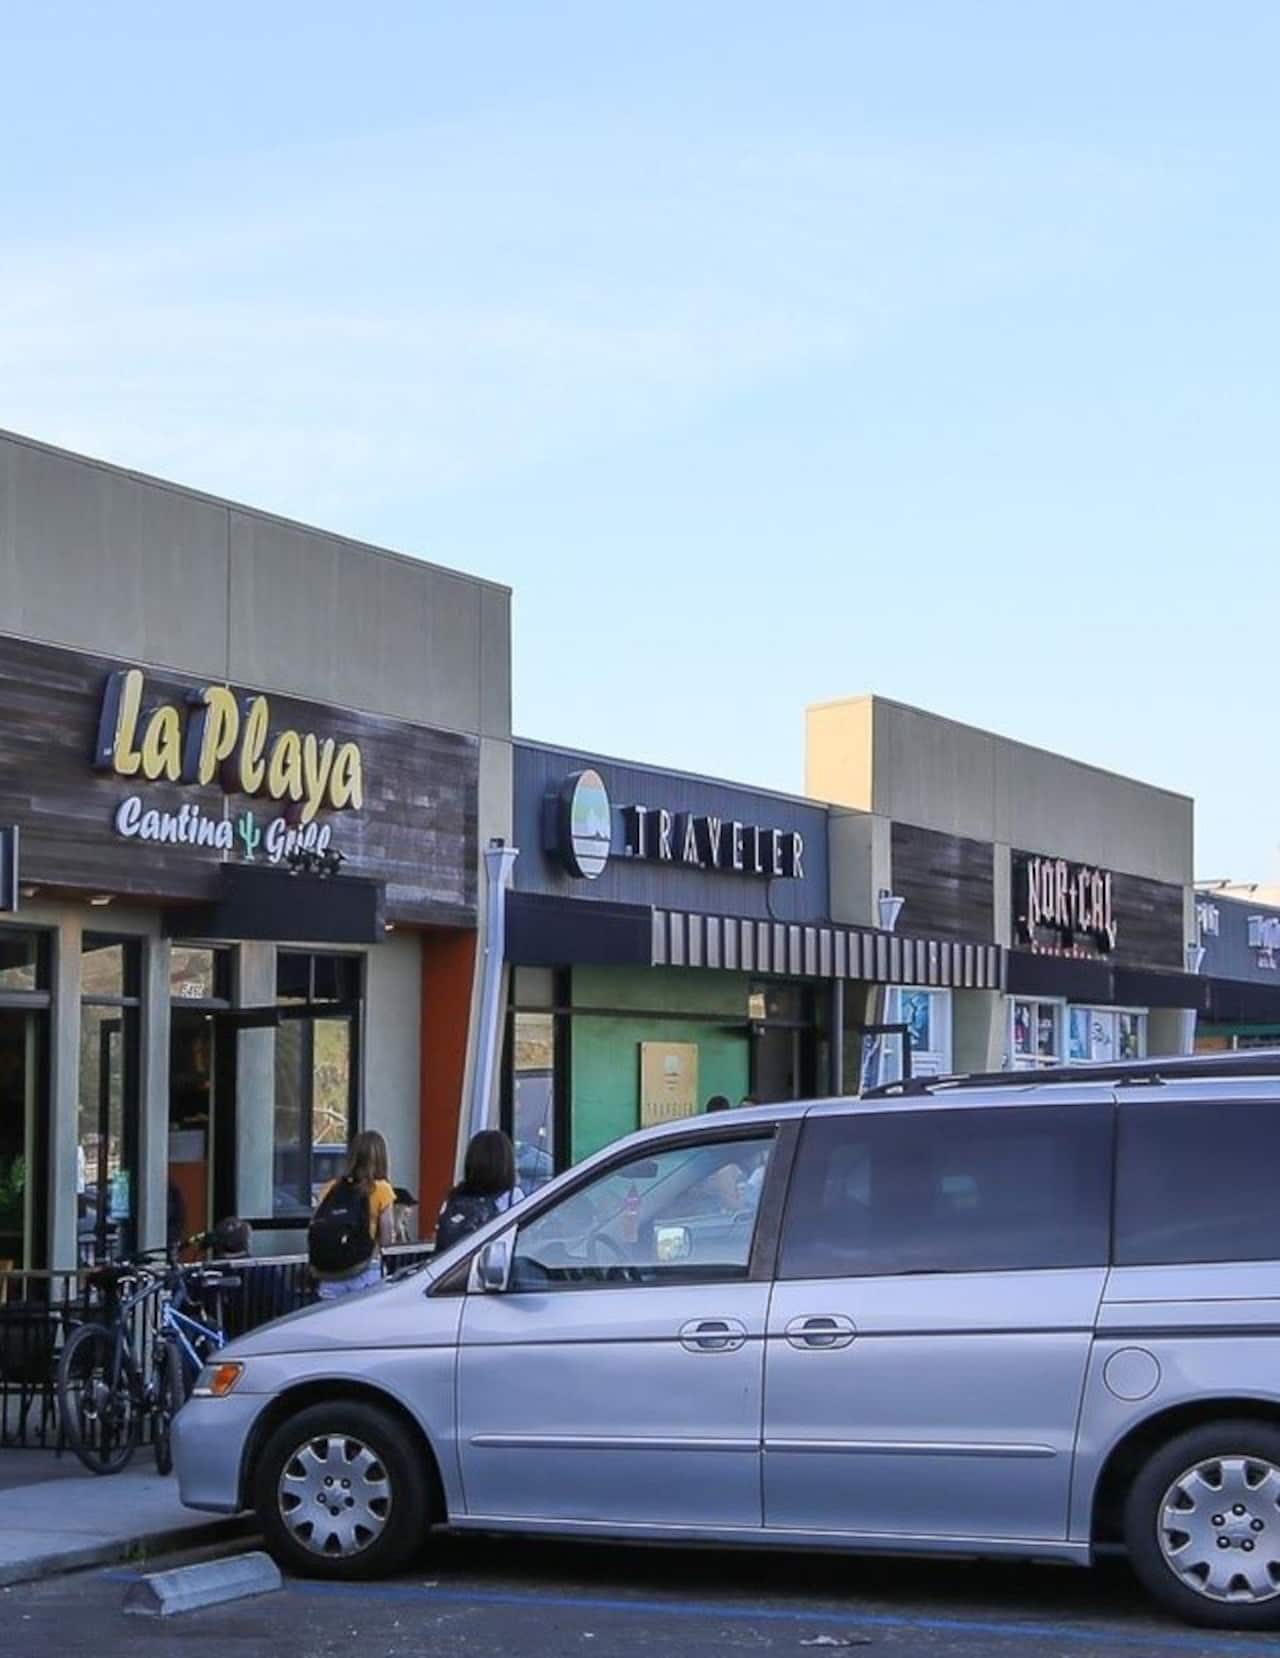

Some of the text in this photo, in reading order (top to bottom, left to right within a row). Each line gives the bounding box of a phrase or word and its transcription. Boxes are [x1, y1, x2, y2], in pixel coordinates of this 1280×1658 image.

[110, 668, 365, 824] La Playa
[116, 796, 333, 864] Cantina Grill
[634, 805, 805, 879] TRAVELER
